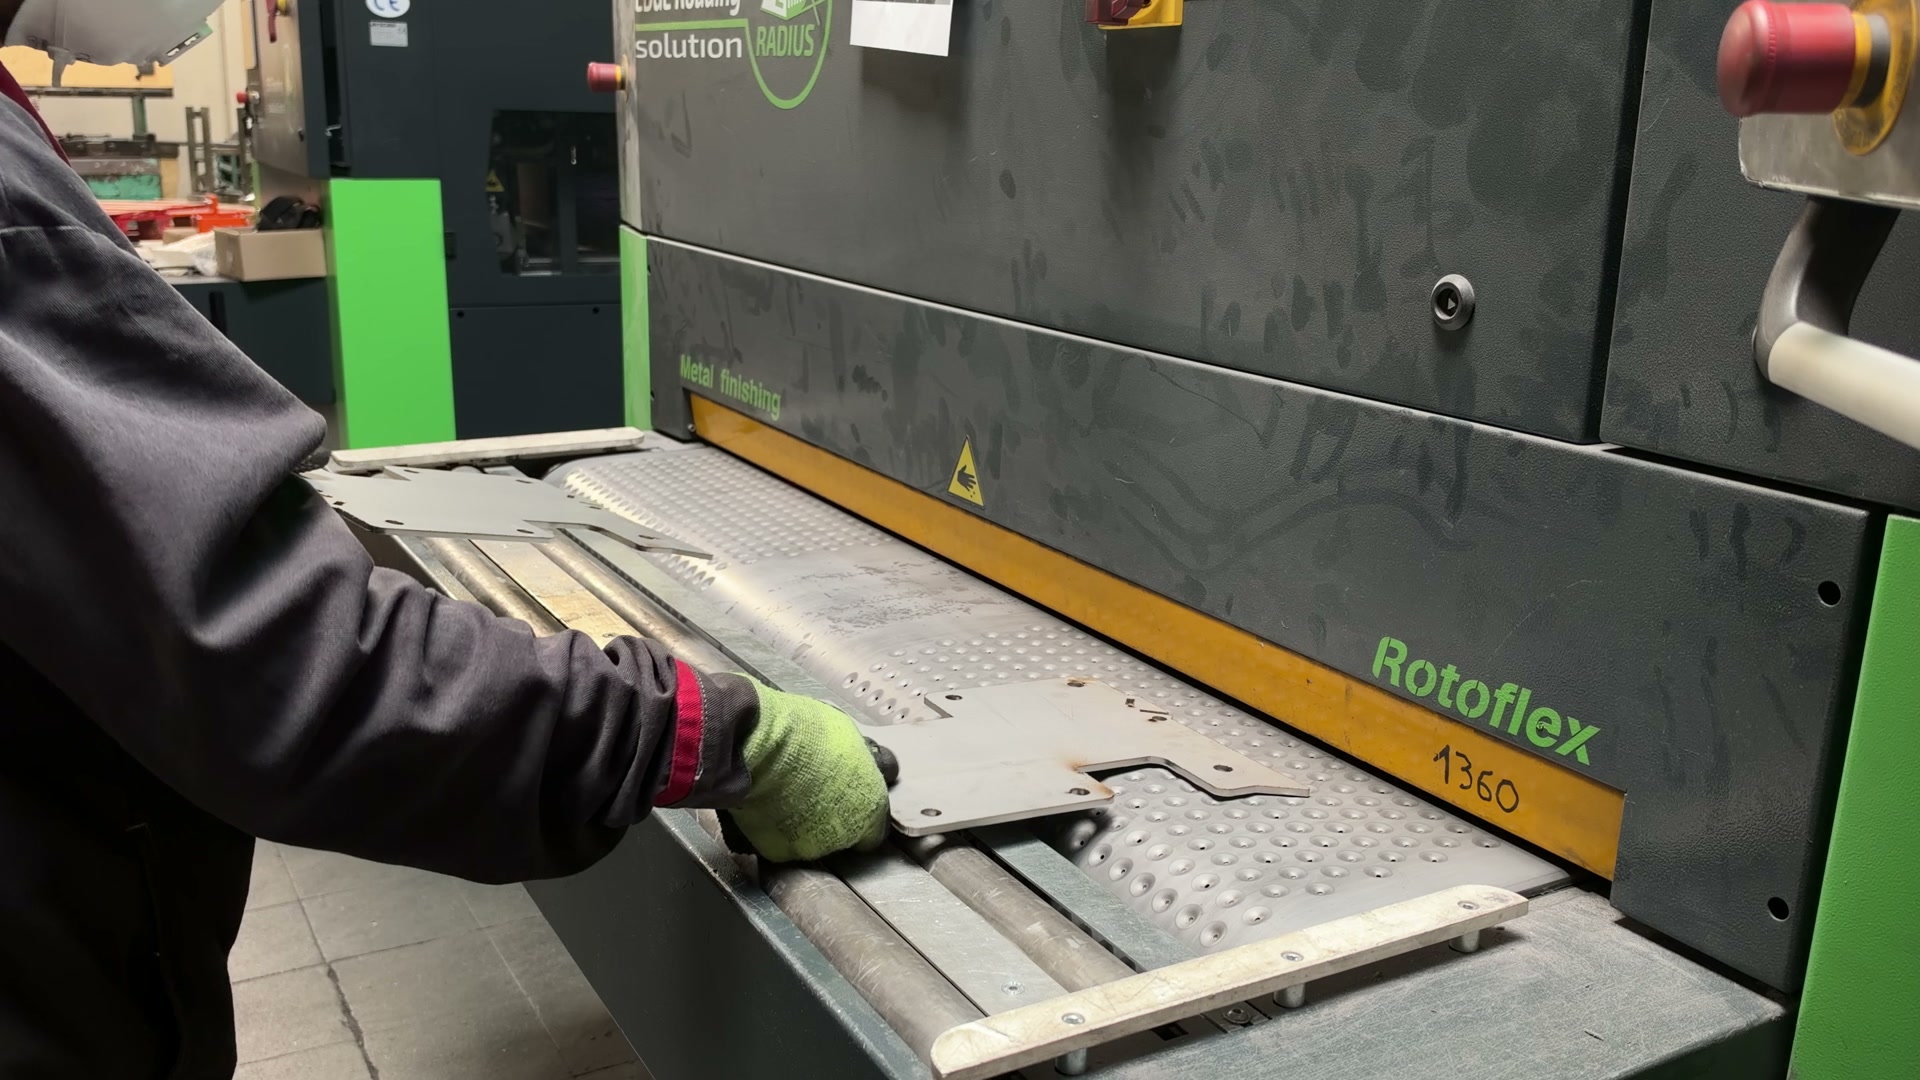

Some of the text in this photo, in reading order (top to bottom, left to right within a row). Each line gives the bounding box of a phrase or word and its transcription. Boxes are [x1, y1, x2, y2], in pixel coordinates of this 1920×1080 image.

[635, 32, 743, 59] solution
[755, 24, 816, 57] RADIUS
[680, 353, 782, 421] Metal finishing
[1372, 636, 1600, 766] Rotoflex
[1433, 744, 1519, 813] 1360
